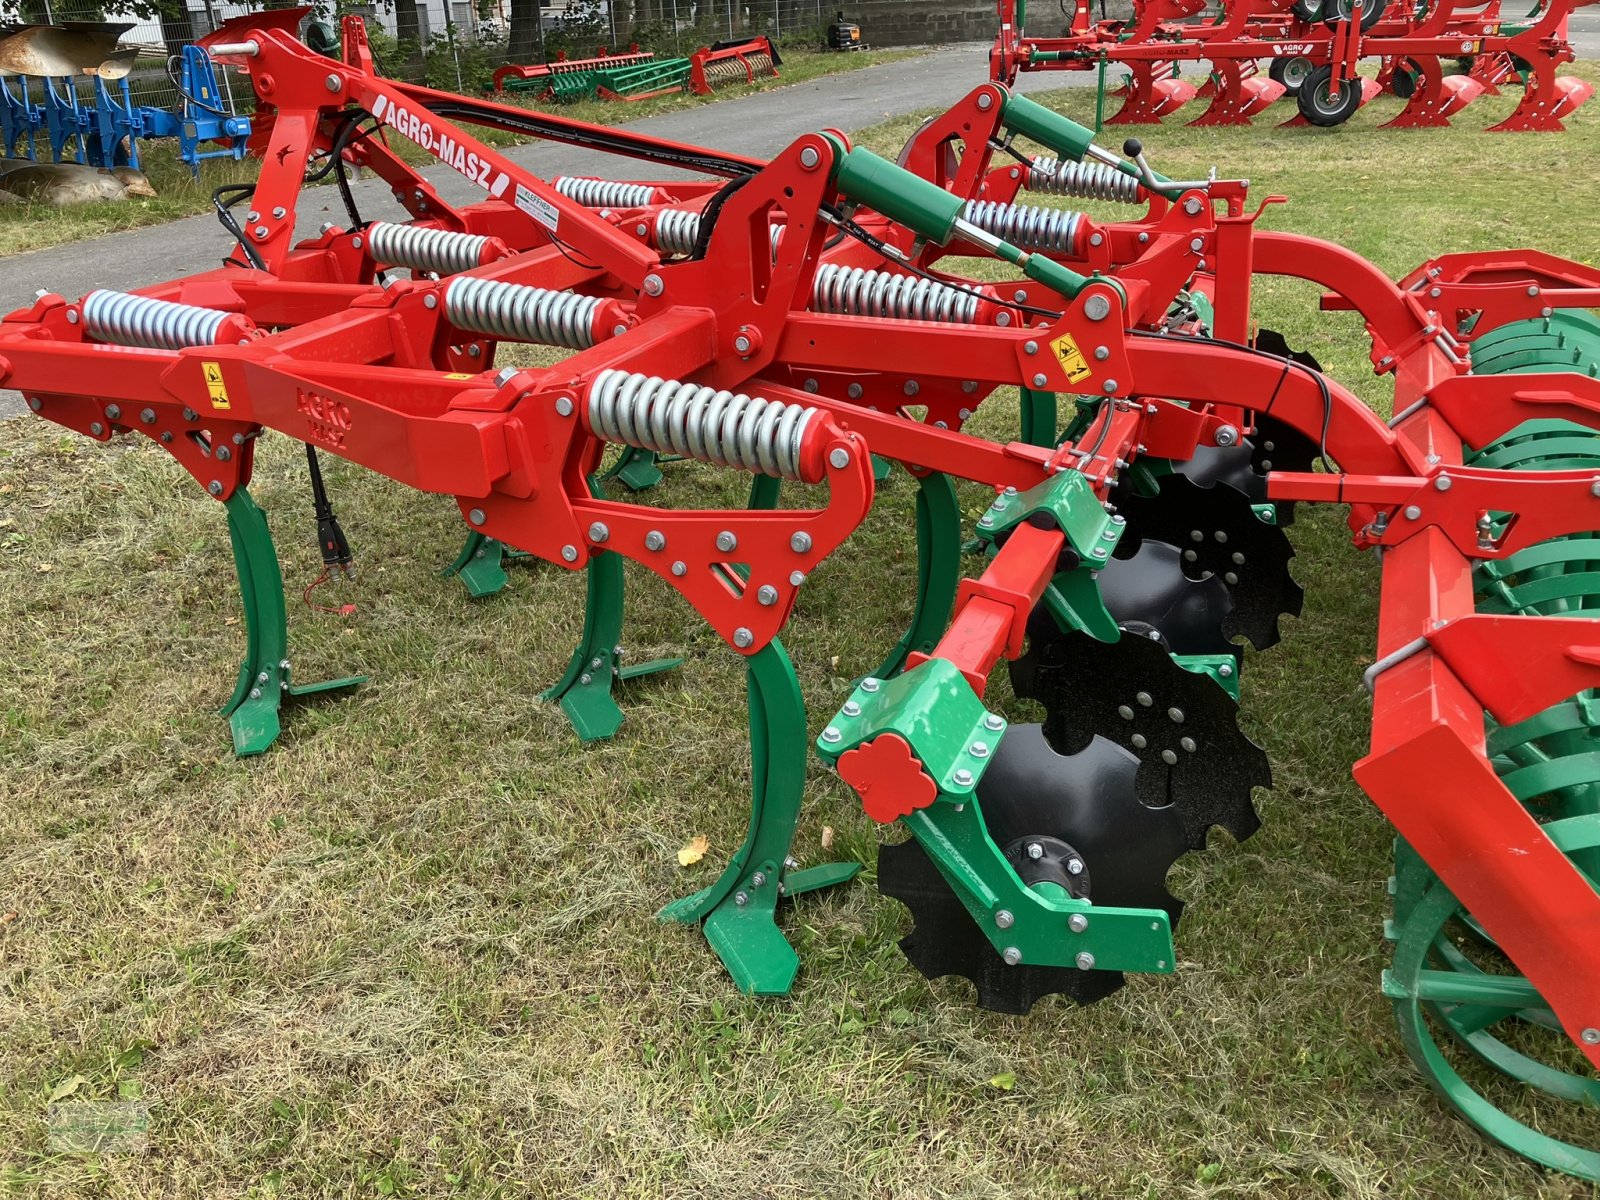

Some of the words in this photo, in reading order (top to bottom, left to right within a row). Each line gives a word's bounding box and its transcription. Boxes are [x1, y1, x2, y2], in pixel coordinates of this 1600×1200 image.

[385, 101, 492, 191] AGRO-MASZ
[524, 191, 551, 212] KLEFFNER
[297, 387, 352, 431] AGRO
